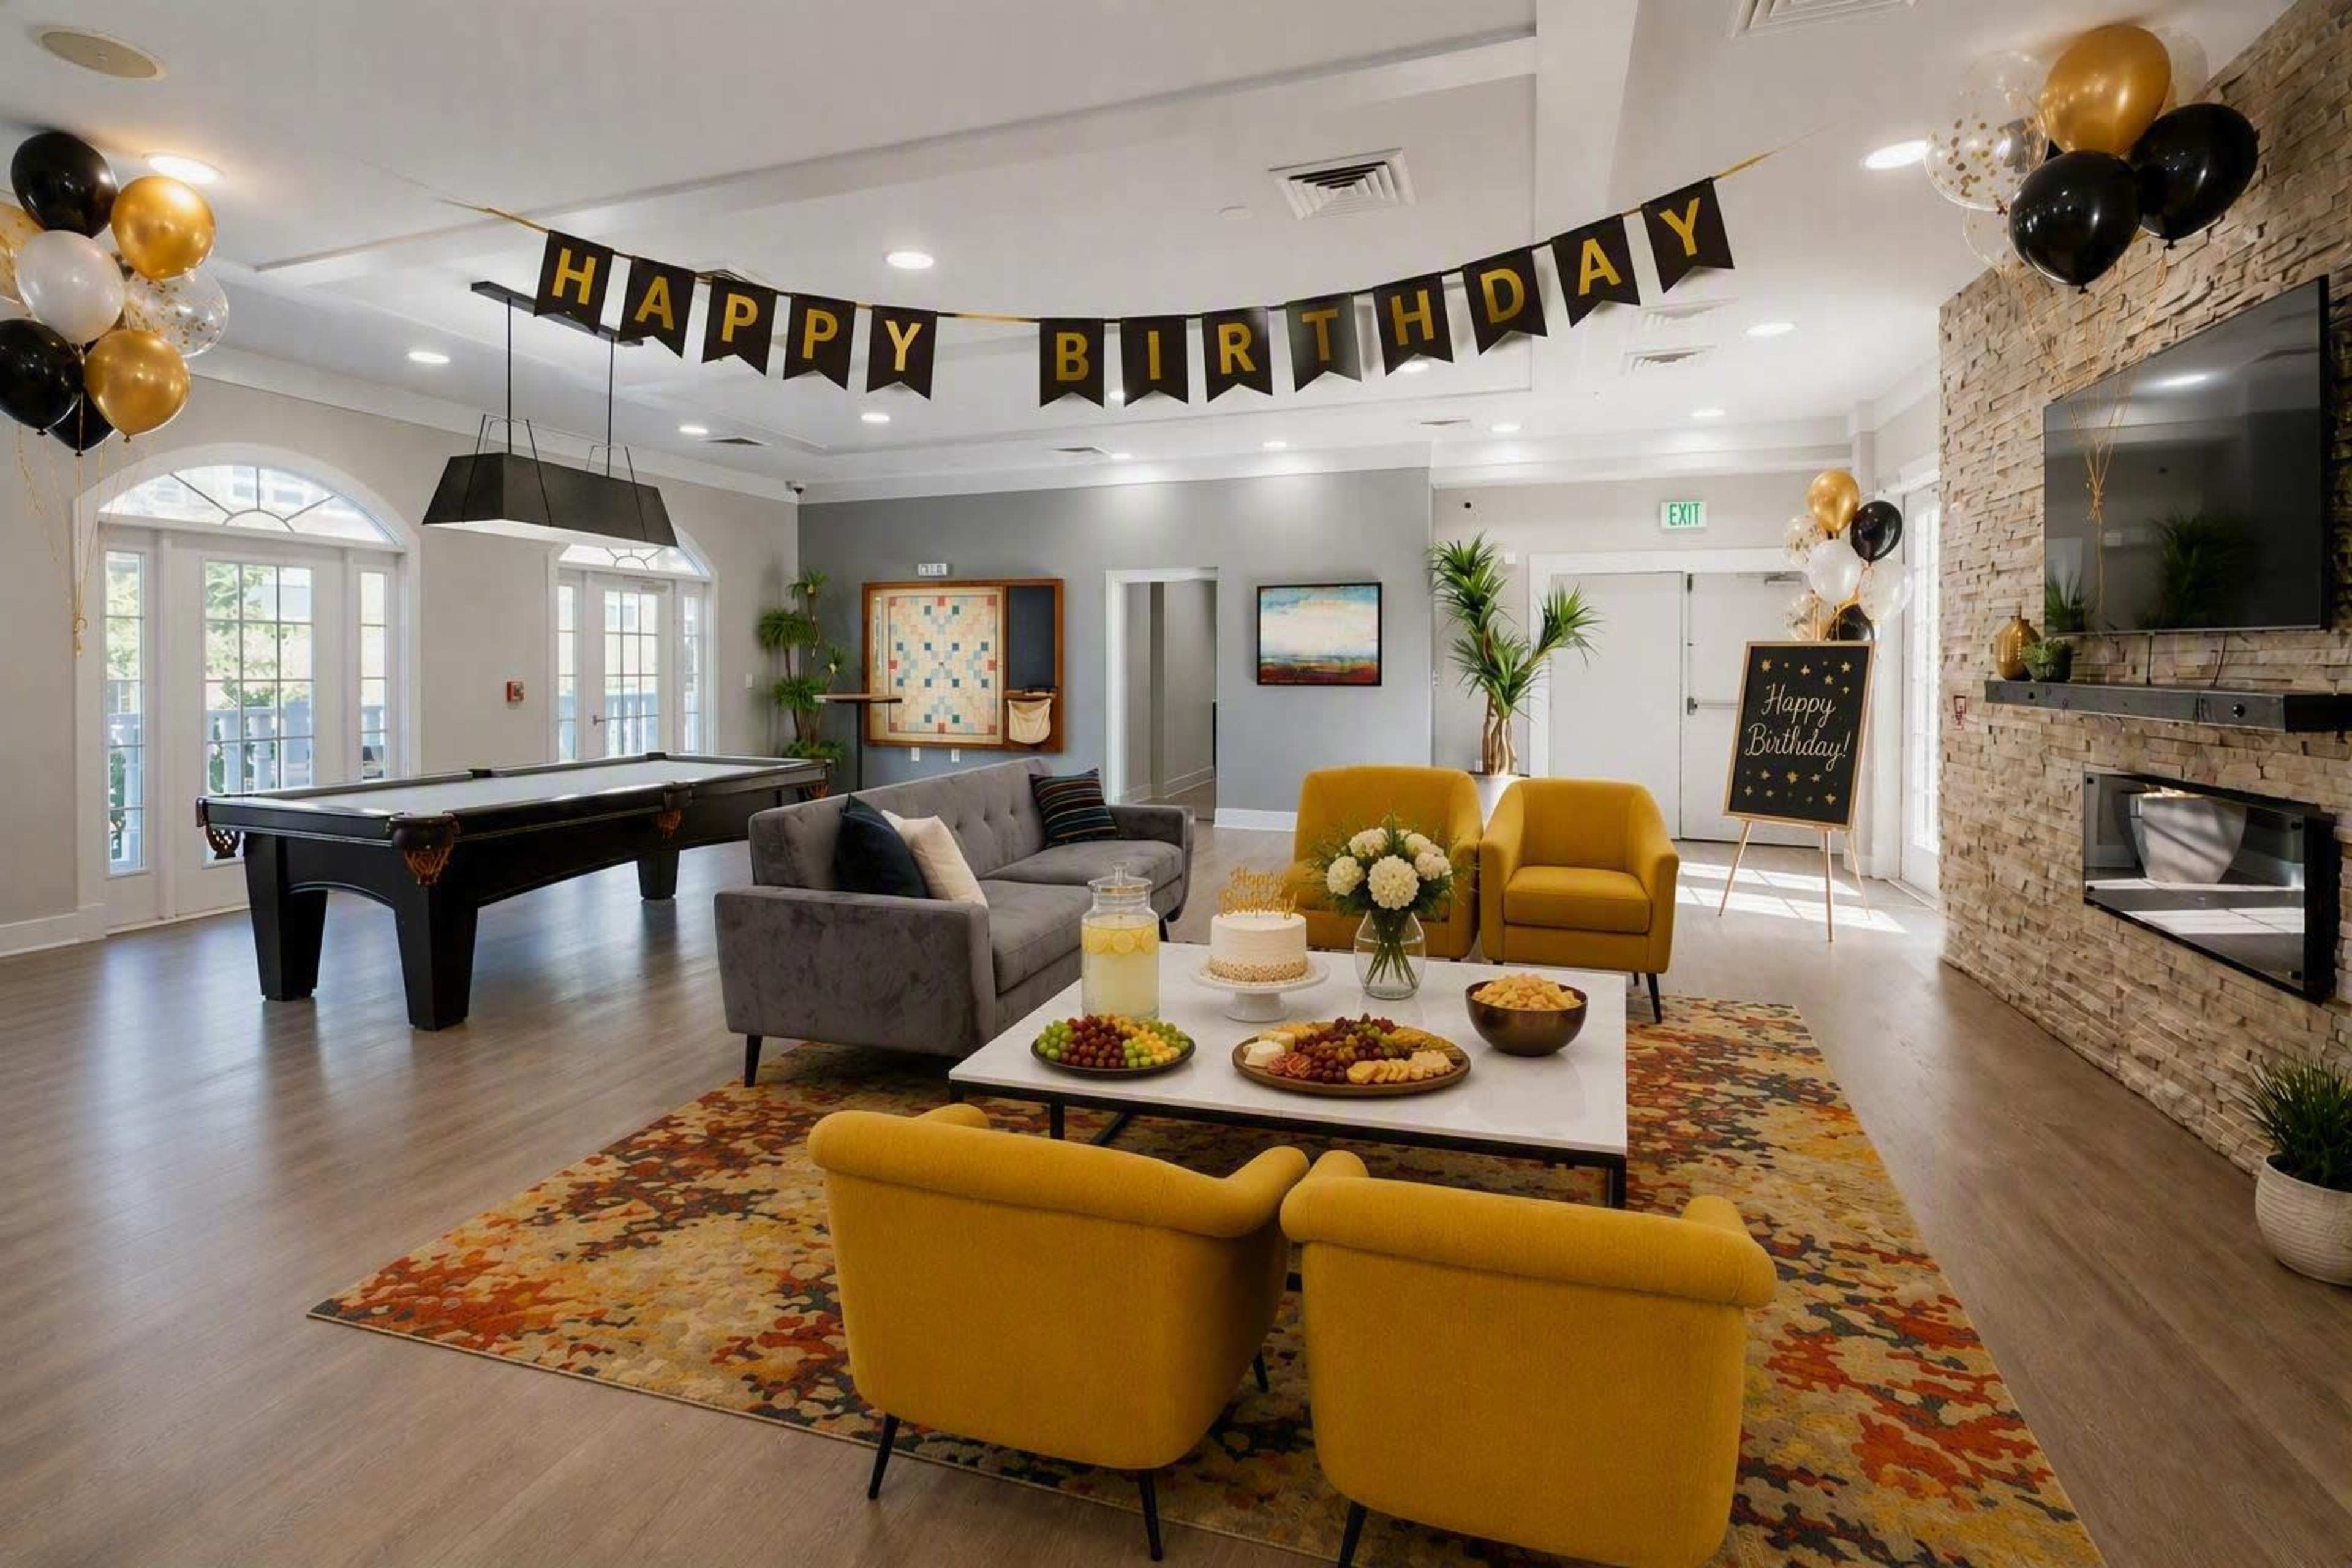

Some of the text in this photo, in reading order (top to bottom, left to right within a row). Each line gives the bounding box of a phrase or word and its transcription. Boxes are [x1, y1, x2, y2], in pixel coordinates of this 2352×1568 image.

[552, 197, 1700, 380] HAPPY BIRTHDAY
[1669, 503, 1700, 526] EXIT
[1761, 682, 1836, 728] Happy
[1744, 722, 1850, 771] Birthday!
